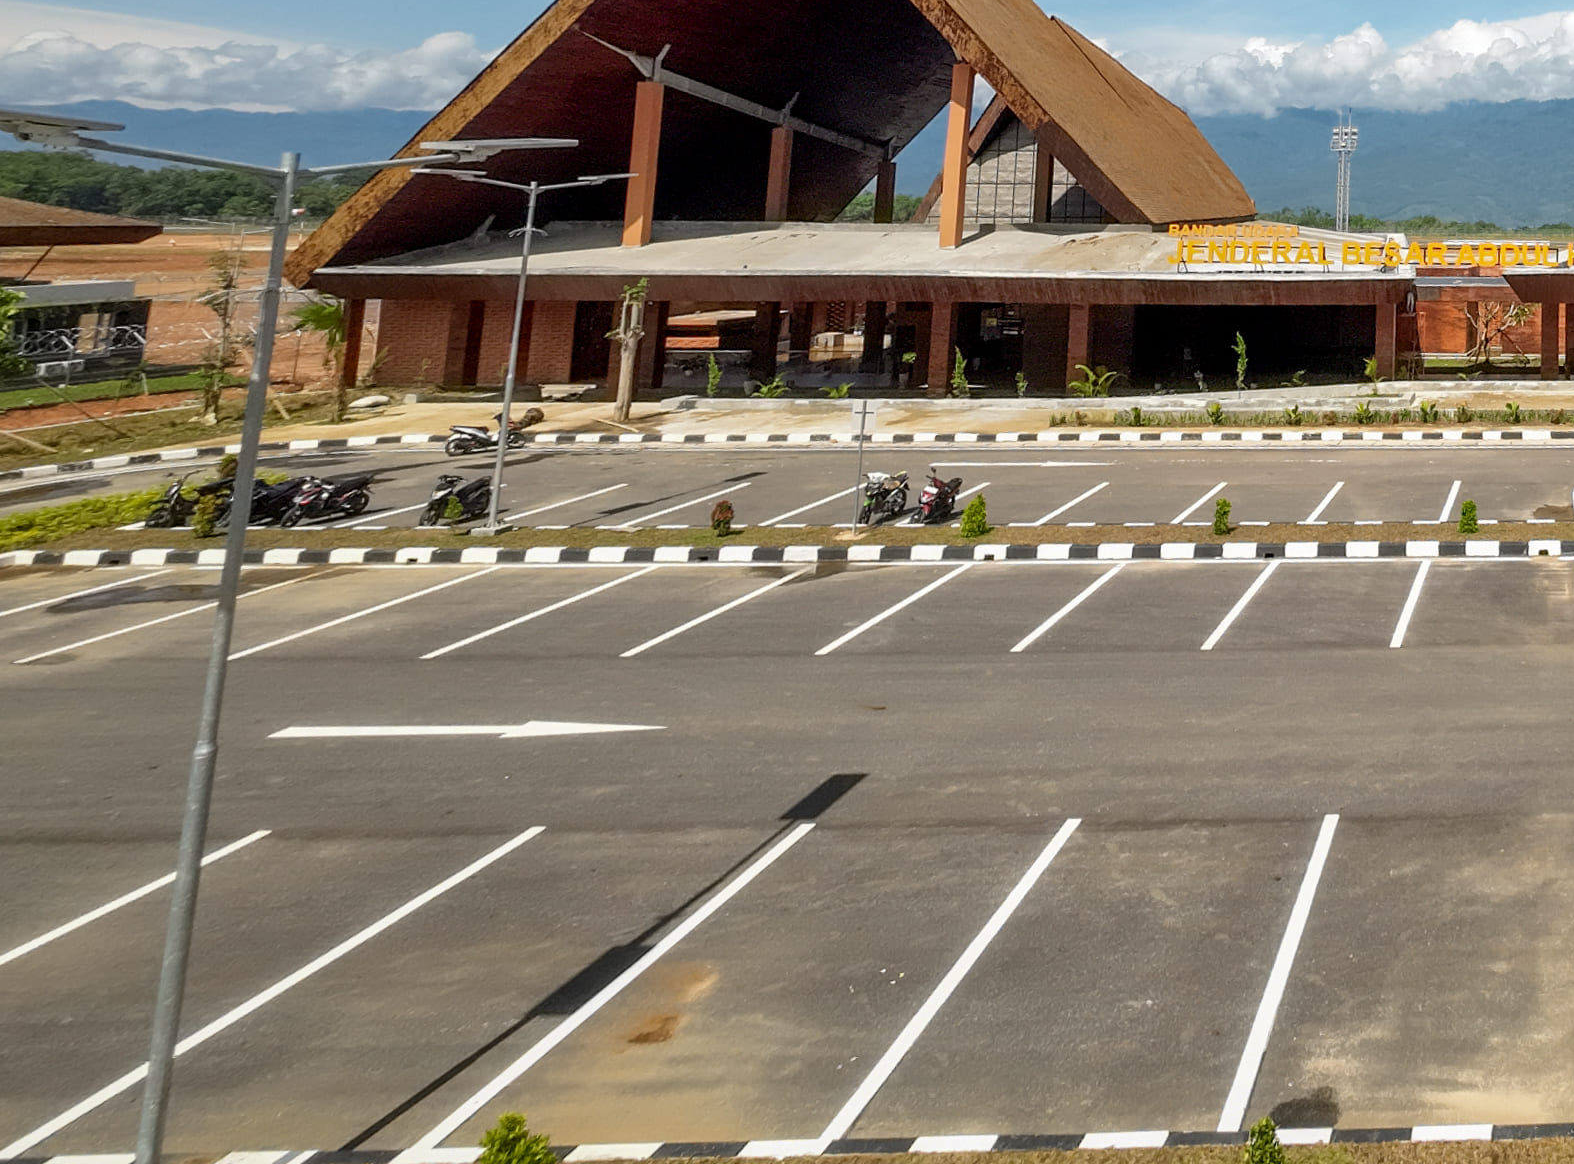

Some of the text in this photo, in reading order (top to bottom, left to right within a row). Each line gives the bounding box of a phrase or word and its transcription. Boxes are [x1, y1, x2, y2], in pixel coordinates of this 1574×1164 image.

[1168, 223, 1237, 237] BANDAR
[1167, 239, 1335, 265] JENDERAL
[1342, 241, 1449, 267] BESAR
[1455, 242, 1559, 267] ABDUL
